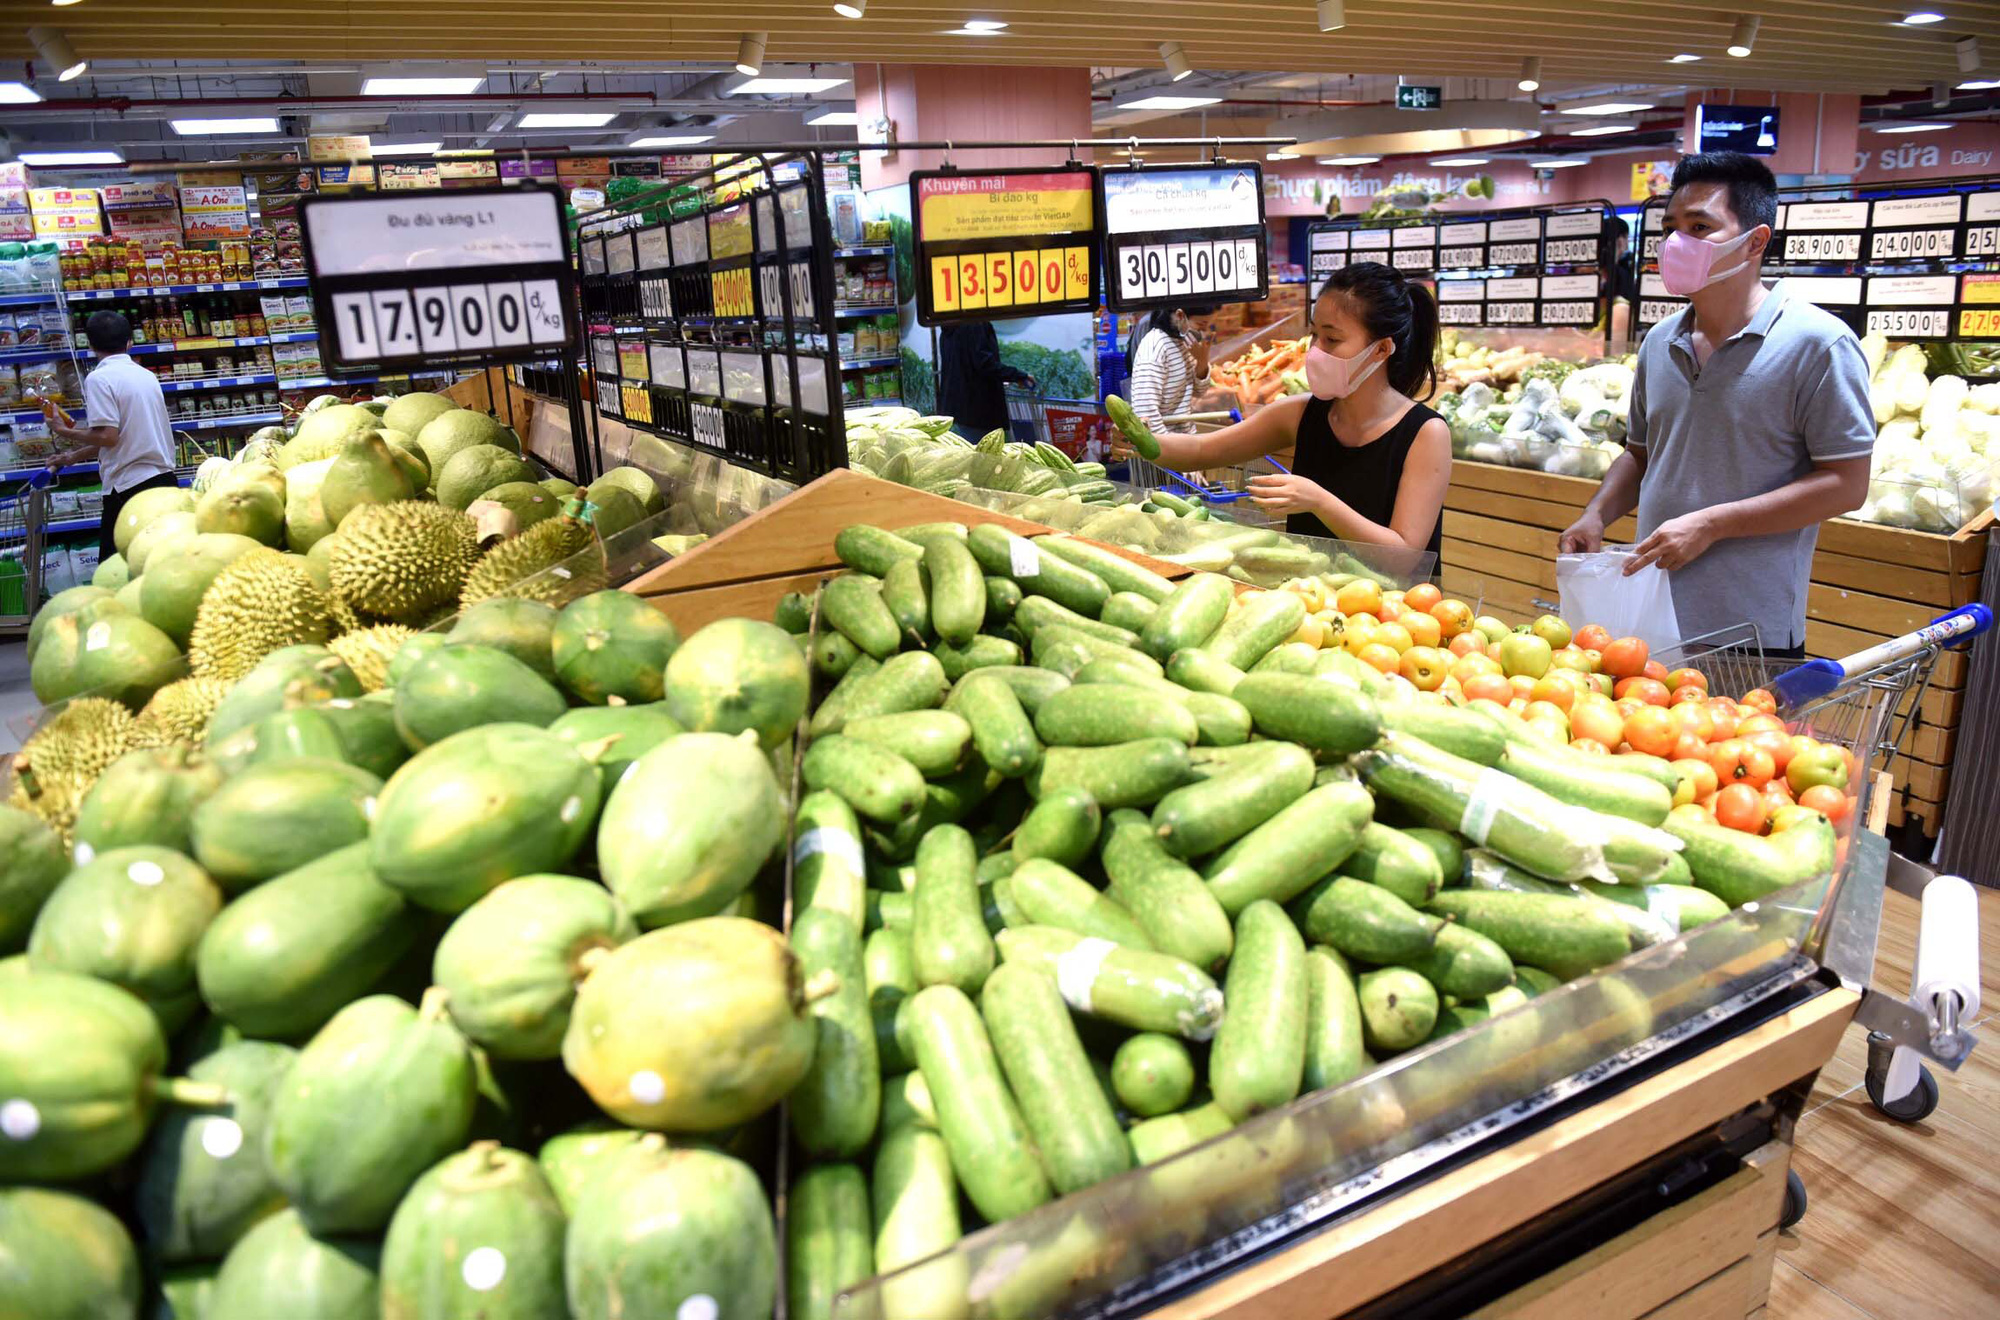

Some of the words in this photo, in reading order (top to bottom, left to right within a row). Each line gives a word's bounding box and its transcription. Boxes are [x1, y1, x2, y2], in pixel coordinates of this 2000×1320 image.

[1880, 142, 1940, 170] sữa
[1950, 149, 1992, 167] Dairy
[1026, 192, 1039, 204] kg
[1788, 238, 1844, 255] 38.900
[1876, 234, 1936, 253] 24.000
[1127, 248, 1232, 286] 30.500
[941, 259, 1061, 302] 13.500
[347, 293, 520, 344] 17.900
[1870, 314, 1930, 331] 25.500
[79, 556, 98, 565] Sele
